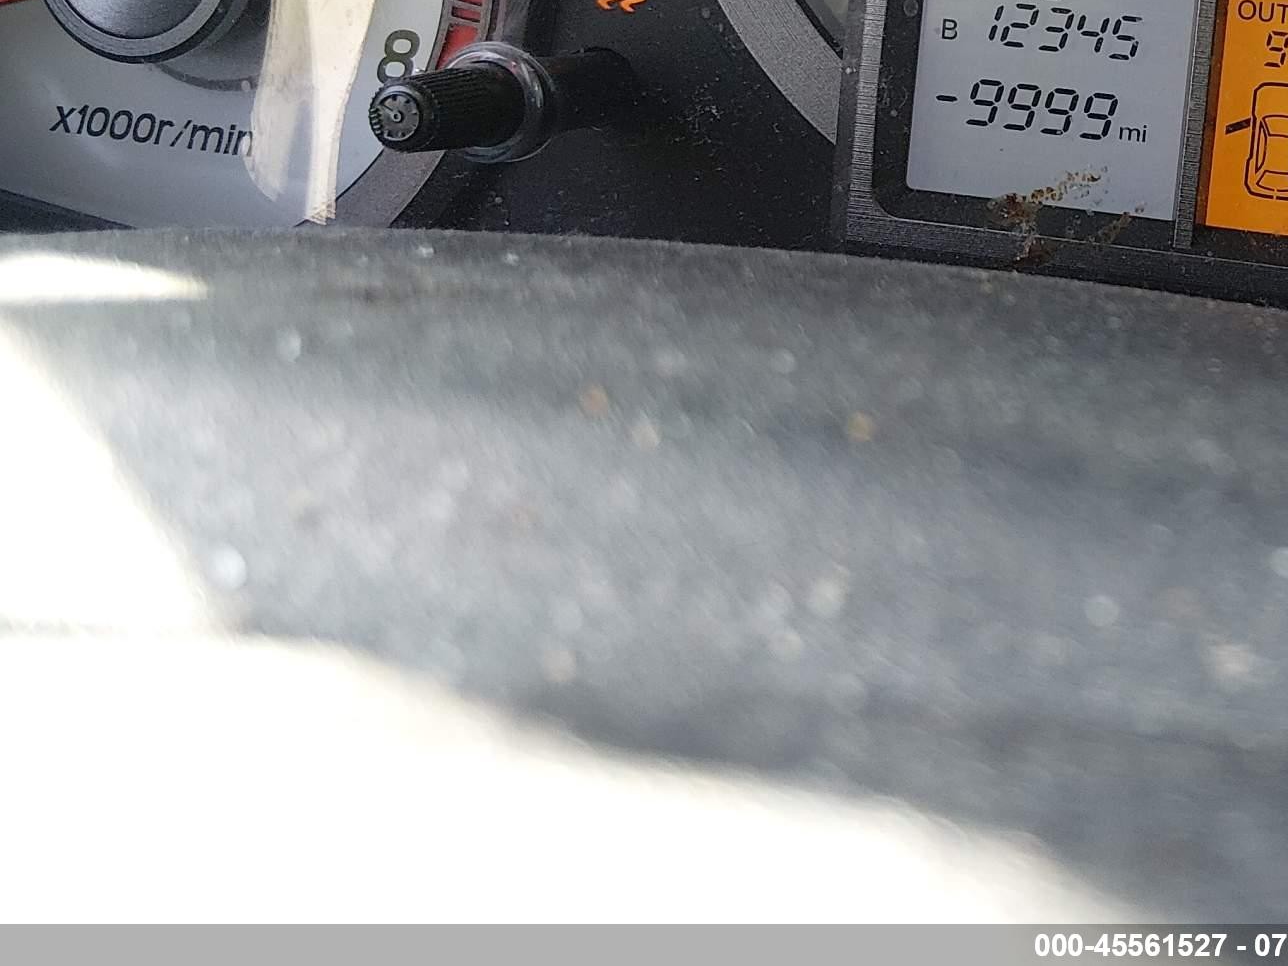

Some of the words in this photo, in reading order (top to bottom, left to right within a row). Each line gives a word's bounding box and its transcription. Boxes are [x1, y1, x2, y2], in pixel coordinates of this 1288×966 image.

[377, 29, 420, 84] 8
[942, 19, 958, 40] B
[989, 4, 1143, 61] 12345
[1119, 121, 1147, 143] mi
